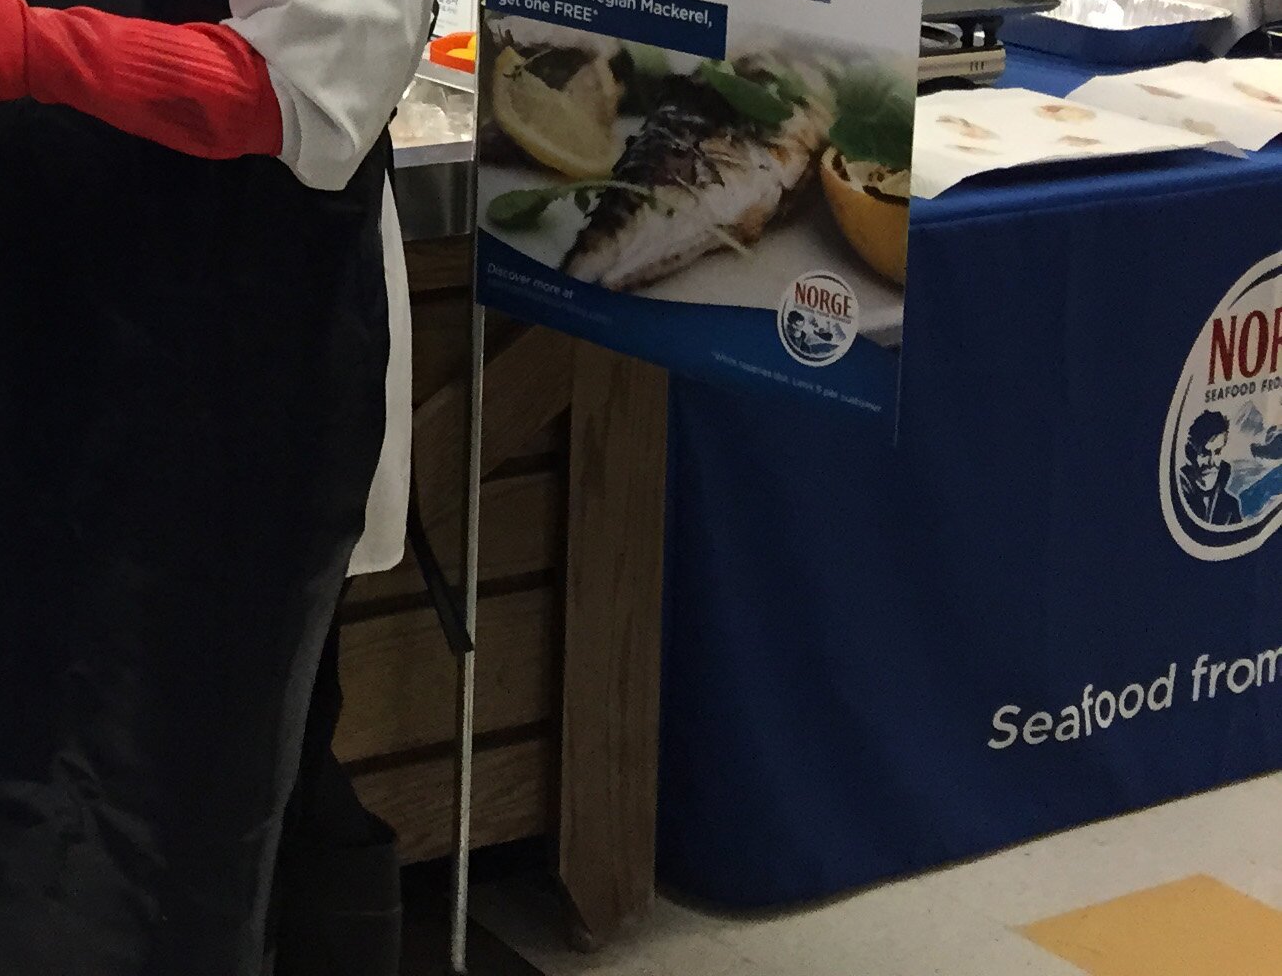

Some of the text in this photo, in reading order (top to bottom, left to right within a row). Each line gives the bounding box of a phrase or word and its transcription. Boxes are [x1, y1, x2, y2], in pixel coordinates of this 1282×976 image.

[487, 262, 575, 300] Discover more at
[794, 281, 853, 320] NORGE
[1204, 381, 1256, 403] SEAFOOD
[987, 663, 1177, 750] Seafood
